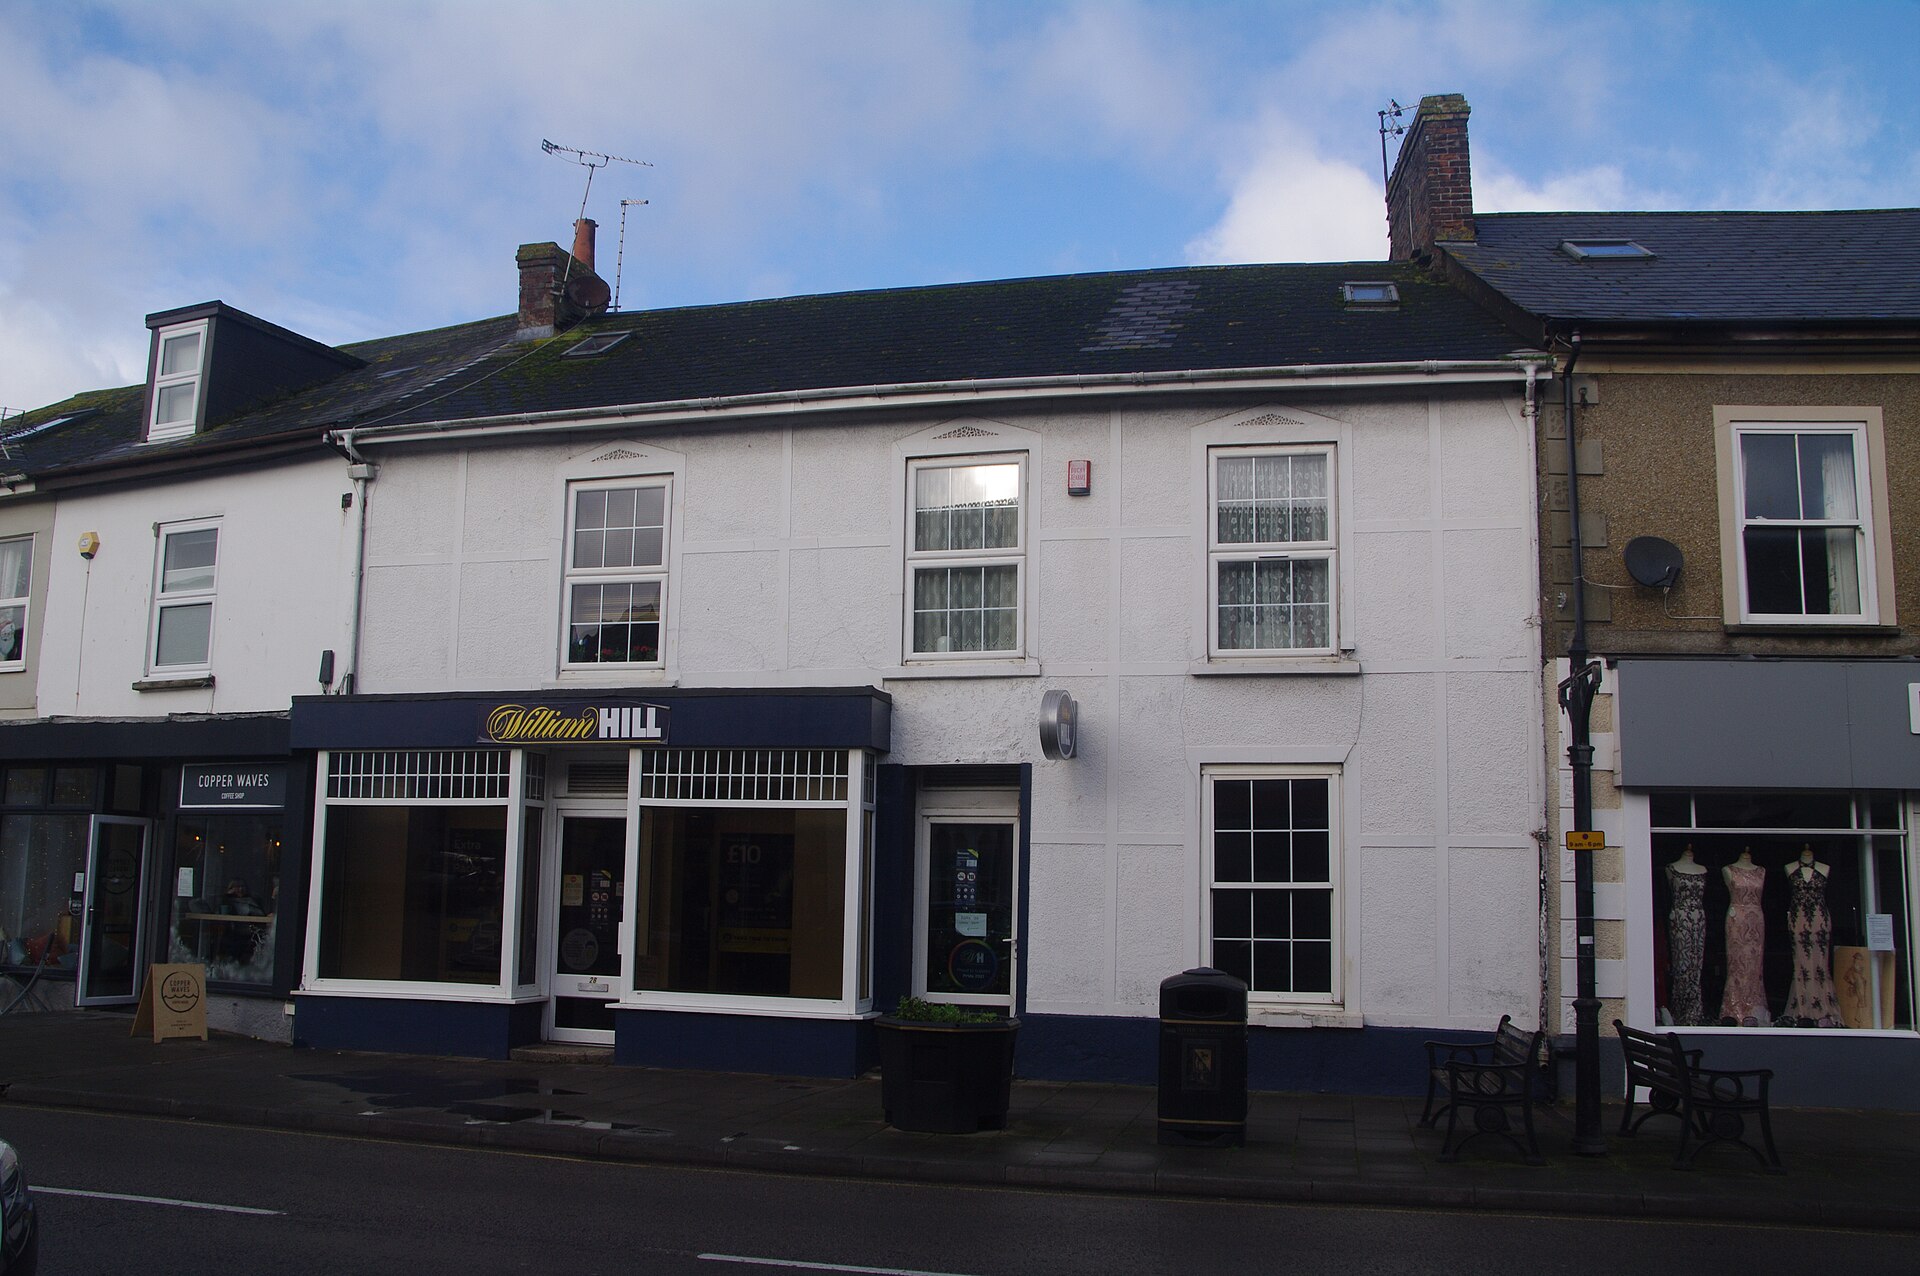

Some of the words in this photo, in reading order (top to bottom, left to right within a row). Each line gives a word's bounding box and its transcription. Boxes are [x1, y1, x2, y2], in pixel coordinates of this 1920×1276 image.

[487, 704, 599, 743] William
[599, 707, 661, 738] HILL
[198, 775, 233, 788] COPPER
[236, 773, 269, 787] WAVES
[221, 792, 235, 800] COFFEE
[235, 792, 245, 800] SHOP
[727, 844, 761, 864] £10
